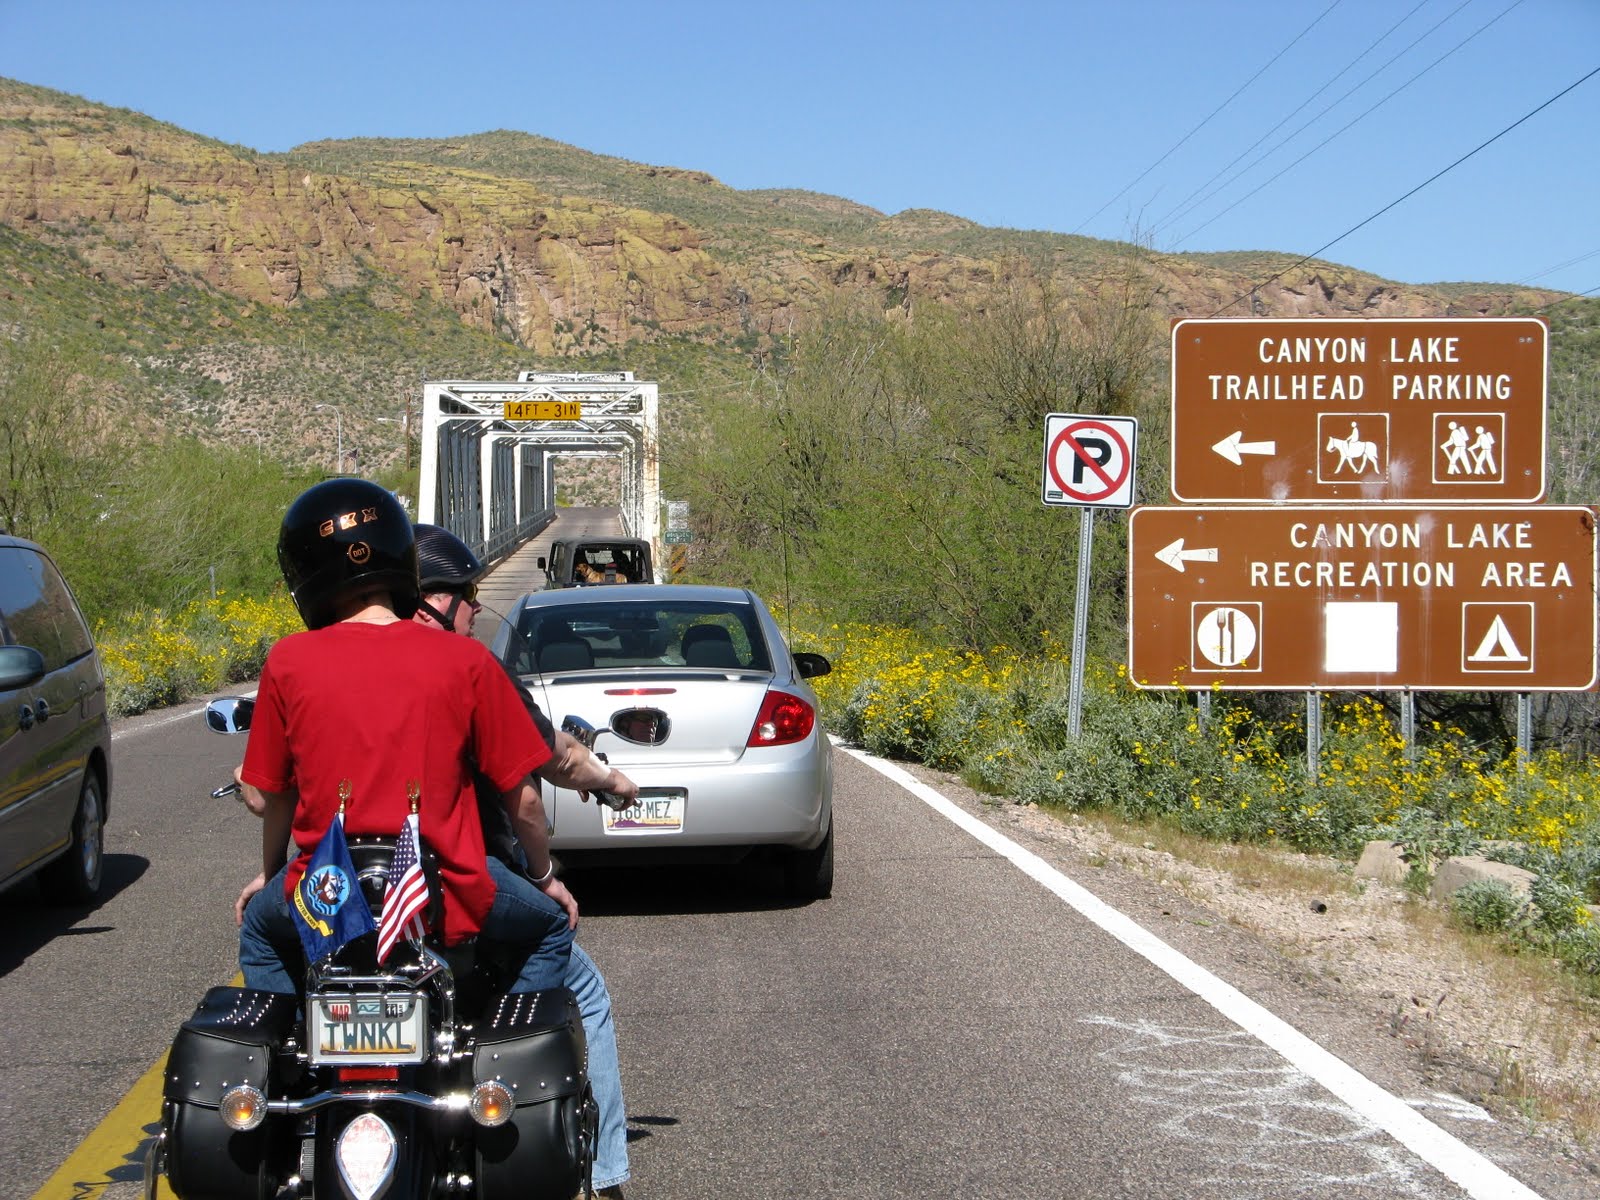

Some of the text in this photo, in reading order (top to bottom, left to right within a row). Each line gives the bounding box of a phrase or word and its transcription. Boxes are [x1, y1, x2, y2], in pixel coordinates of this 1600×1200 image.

[1259, 338, 1459, 363] CANYON LAKE
[1208, 374, 1511, 400] TRAILHEAD PARKING
[1290, 523, 1532, 548] CANYON LAKE
[353, 547, 366, 558] DOT
[1251, 562, 1572, 587] RECREATION AREA
[331, 1005, 349, 1021] MAR
[358, 1004, 380, 1012] AZ
[324, 1022, 412, 1050] TWNKL
